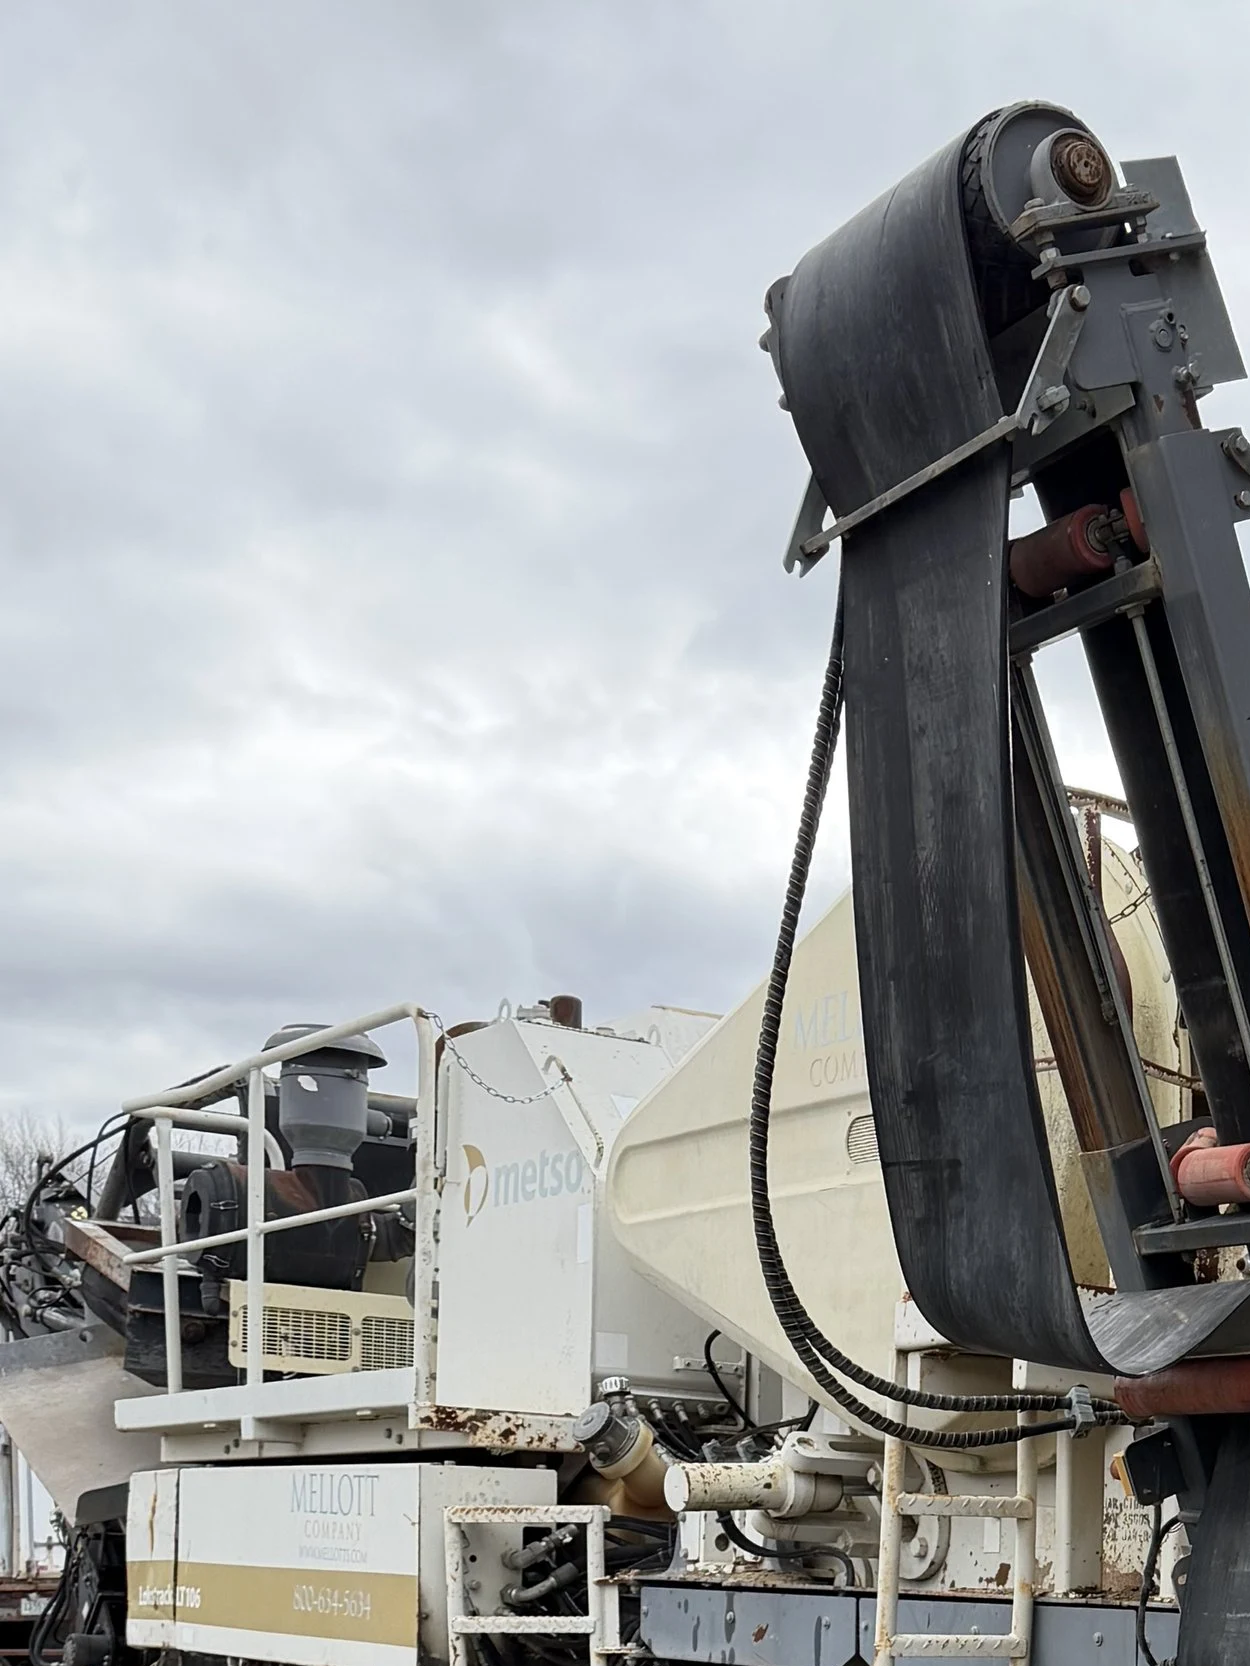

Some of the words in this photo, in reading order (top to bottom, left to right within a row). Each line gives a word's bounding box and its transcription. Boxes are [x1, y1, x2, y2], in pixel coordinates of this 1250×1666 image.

[793, 990, 862, 1051] MEL
[809, 1050, 865, 1087] COM
[493, 1148, 583, 1207] metso
[290, 1472, 380, 1517] MELLOTT
[304, 1519, 362, 1541] COMPANY
[175, 1585, 201, 1608] LT106
[292, 1583, 372, 1621] 800-634-5634
